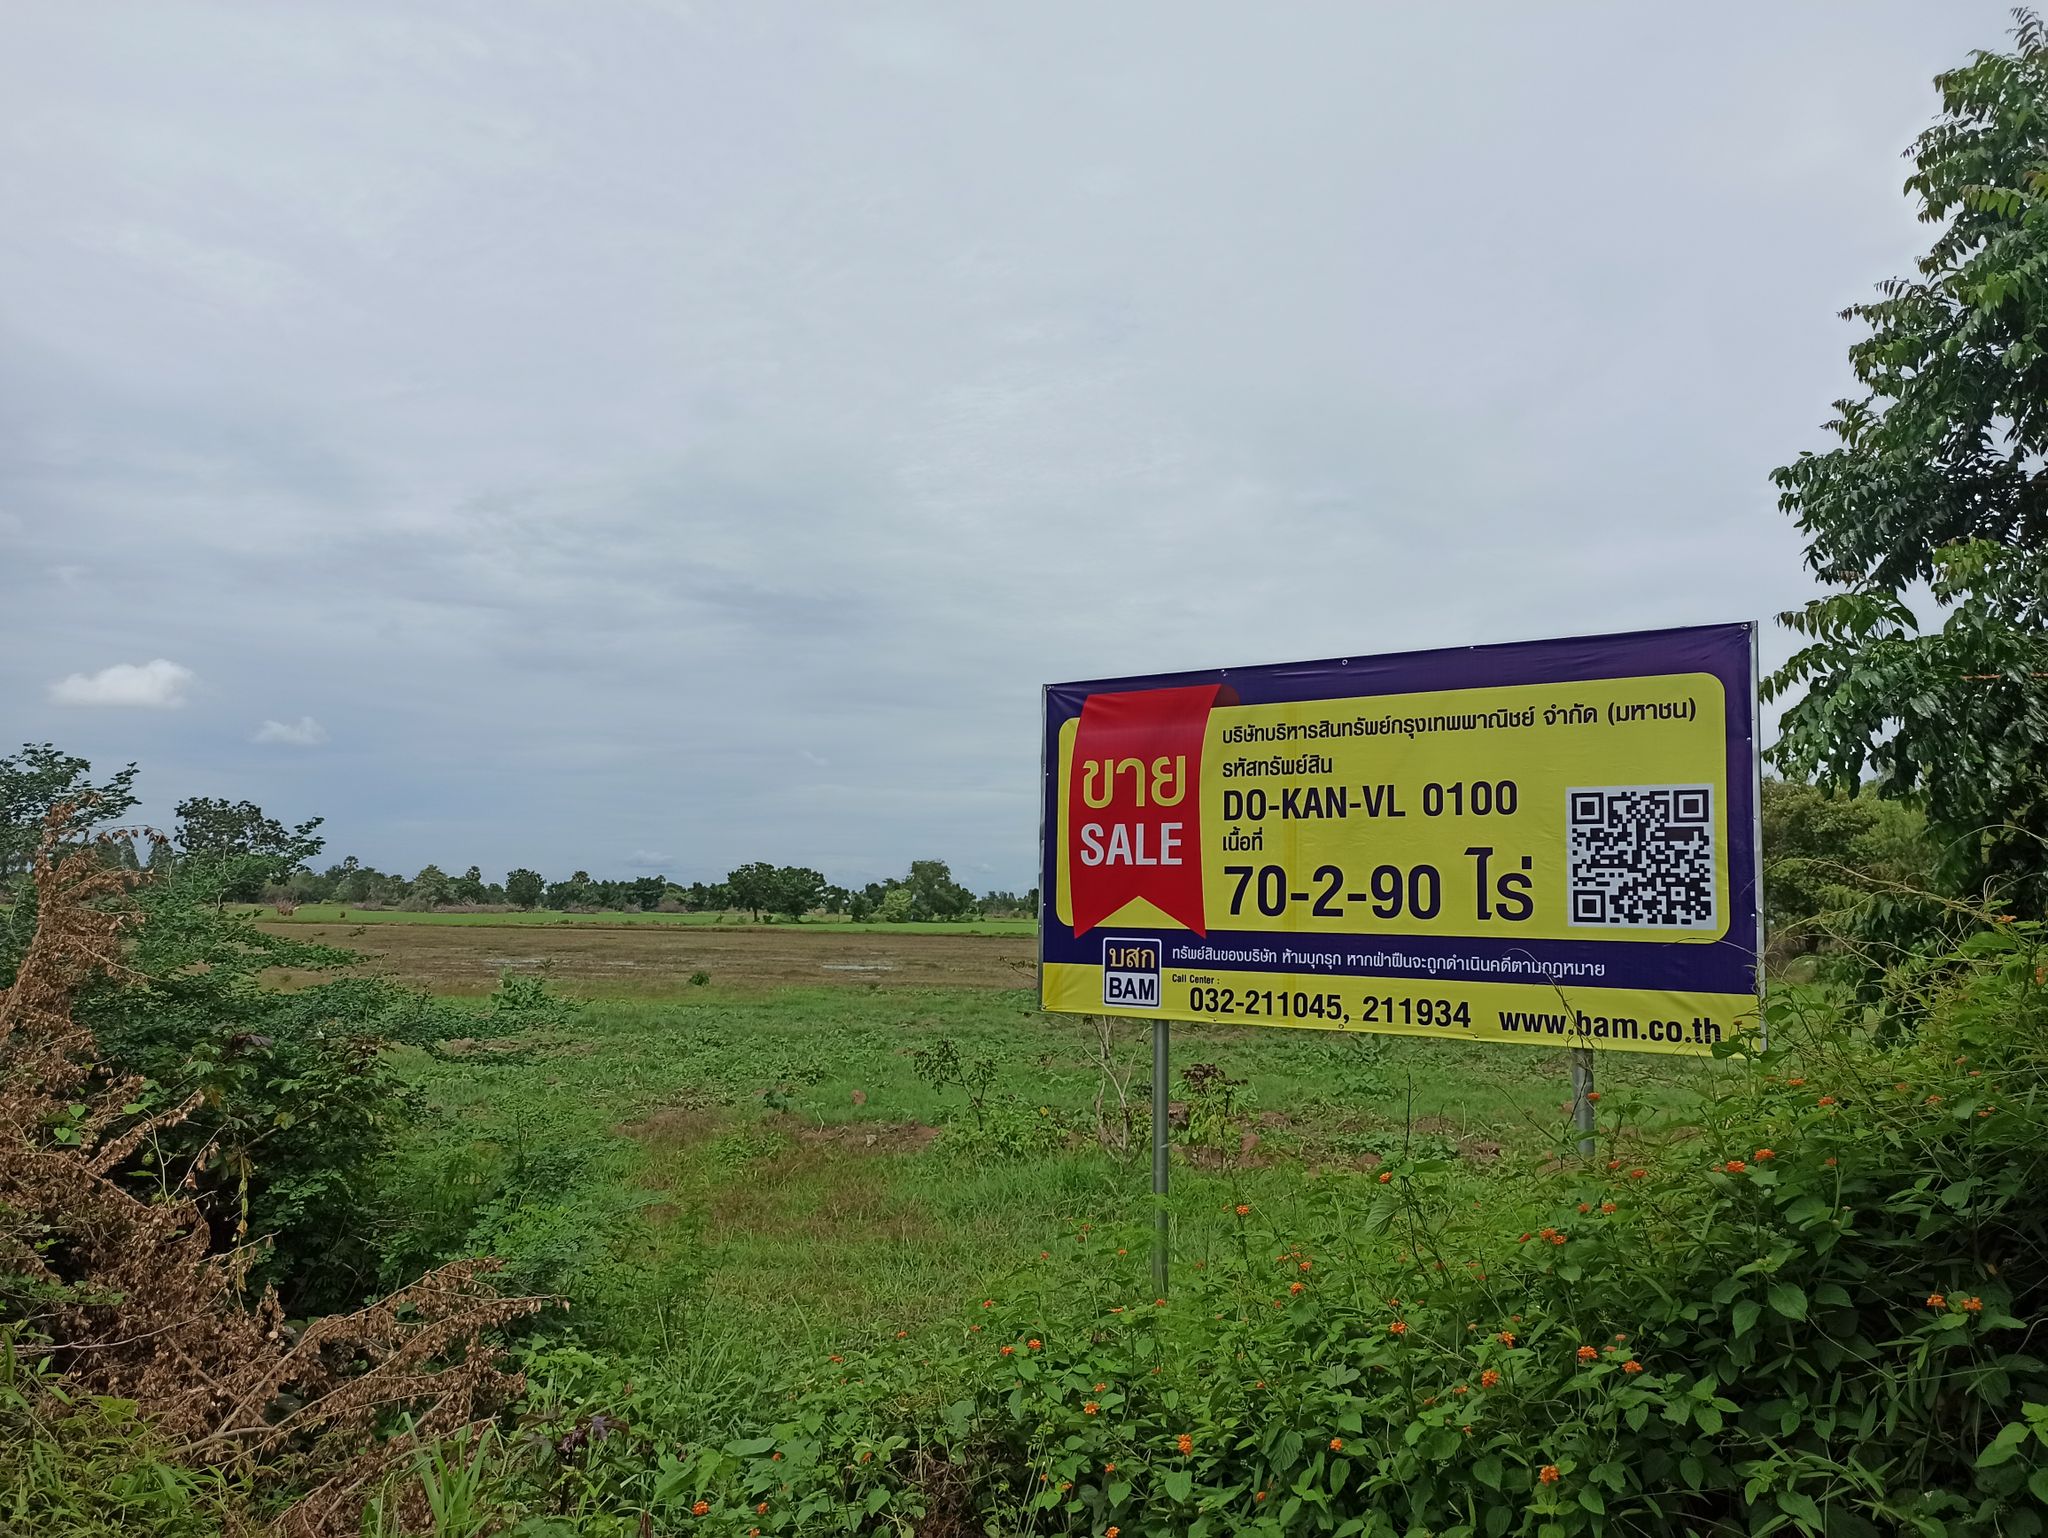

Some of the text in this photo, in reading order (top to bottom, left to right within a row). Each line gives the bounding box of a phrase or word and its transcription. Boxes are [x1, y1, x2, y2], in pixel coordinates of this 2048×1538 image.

[1222, 697, 1697, 741] บริษัทบริหารสินทรัพย์กรุงเทพพาณิชย์ จำกัด (มหาชน)
[1082, 755, 1186, 809] ขาย
[1222, 754, 1333, 778] รหัสทรัพย์สิน
[1223, 780, 1518, 822] DO-KAN-VL 0100
[1080, 822, 1183, 867] SALE
[1222, 827, 1264, 852] เนื้อที่
[1223, 847, 1534, 921] 70-2-90 ไร่
[1108, 947, 1156, 969] บสก
[1172, 946, 1277, 964] ทรัพย์สินของบริษัท
[1282, 950, 1342, 968] ห้ามบุกรุก
[1109, 976, 1155, 1000] BAM
[1172, 973, 1187, 983] Call
[1190, 975, 1215, 985] Center
[1190, 987, 1722, 1044] 032-211045, 211934 www.bam.co.th
